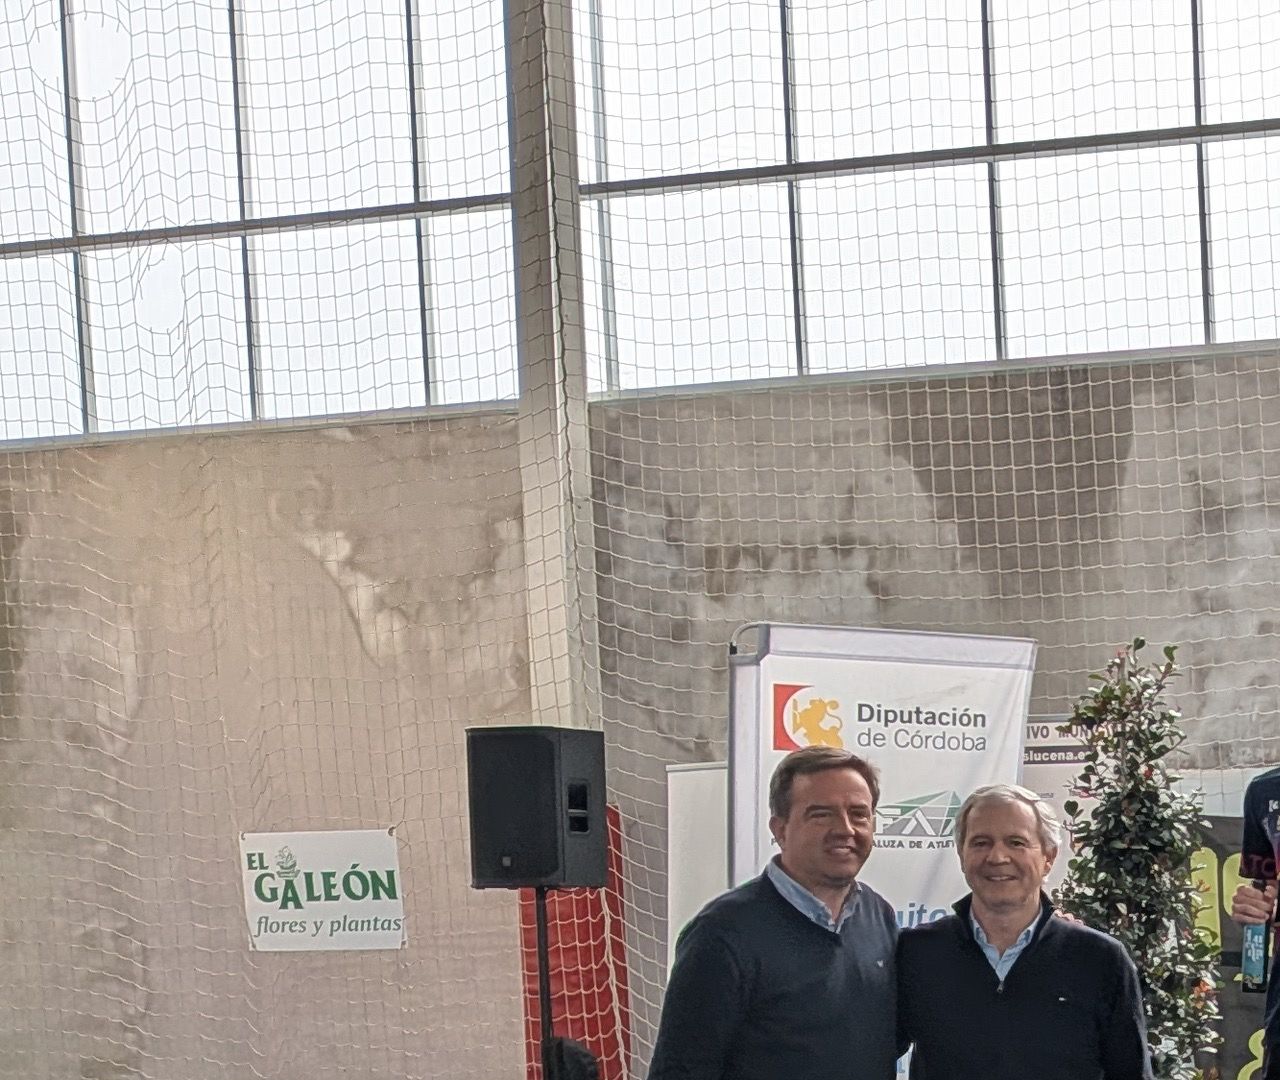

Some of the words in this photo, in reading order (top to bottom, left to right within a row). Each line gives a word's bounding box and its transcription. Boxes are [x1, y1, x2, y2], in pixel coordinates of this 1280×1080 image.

[857, 703, 986, 727] Diputación
[857, 729, 886, 747] de
[894, 729, 986, 750] Córdoba
[909, 840, 923, 849] DE
[246, 853, 269, 870] EL
[254, 863, 398, 910] GALEÓN
[254, 915, 307, 938] flores
[311, 920, 324, 937] y
[329, 915, 402, 937] plantas
